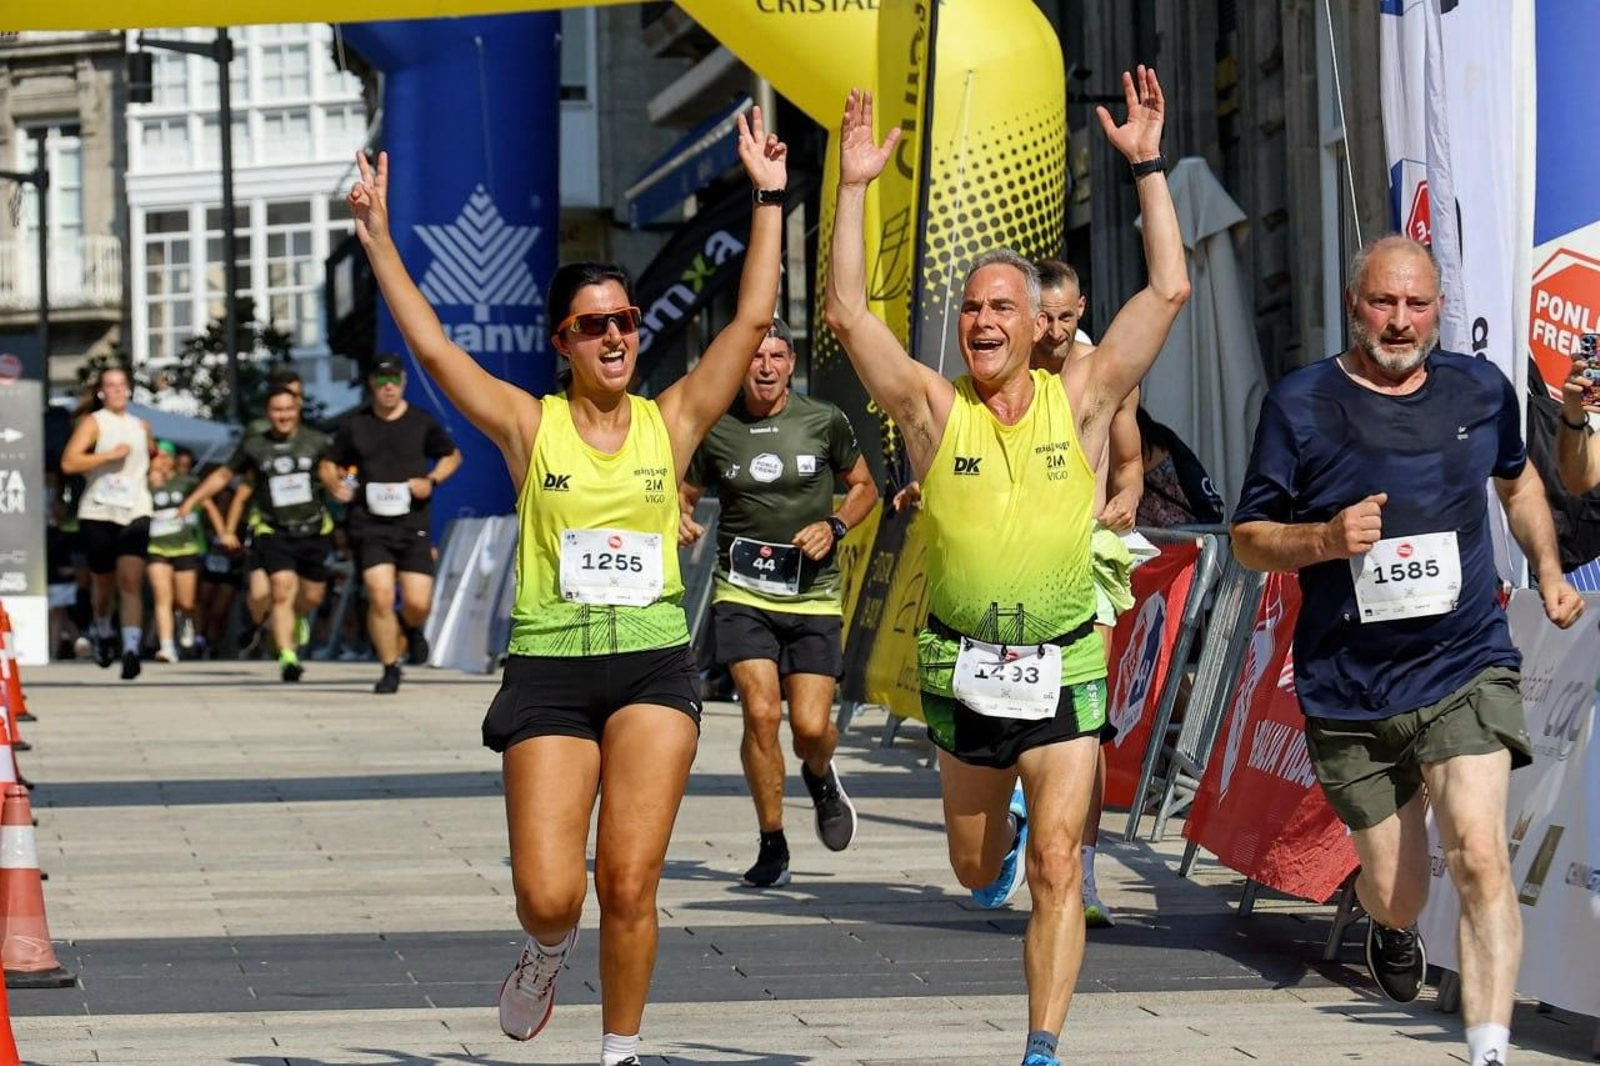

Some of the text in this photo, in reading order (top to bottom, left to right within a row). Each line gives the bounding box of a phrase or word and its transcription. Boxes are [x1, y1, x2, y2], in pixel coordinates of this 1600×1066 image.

[757, 0, 881, 14] CRISTAL
[1535, 289, 1600, 335] PONL
[443, 314, 545, 353] anvi
[953, 456, 982, 473] DK
[543, 472, 572, 489] DK
[581, 552, 643, 573] 1255
[752, 557, 776, 572] 44
[1373, 559, 1440, 585] 1585
